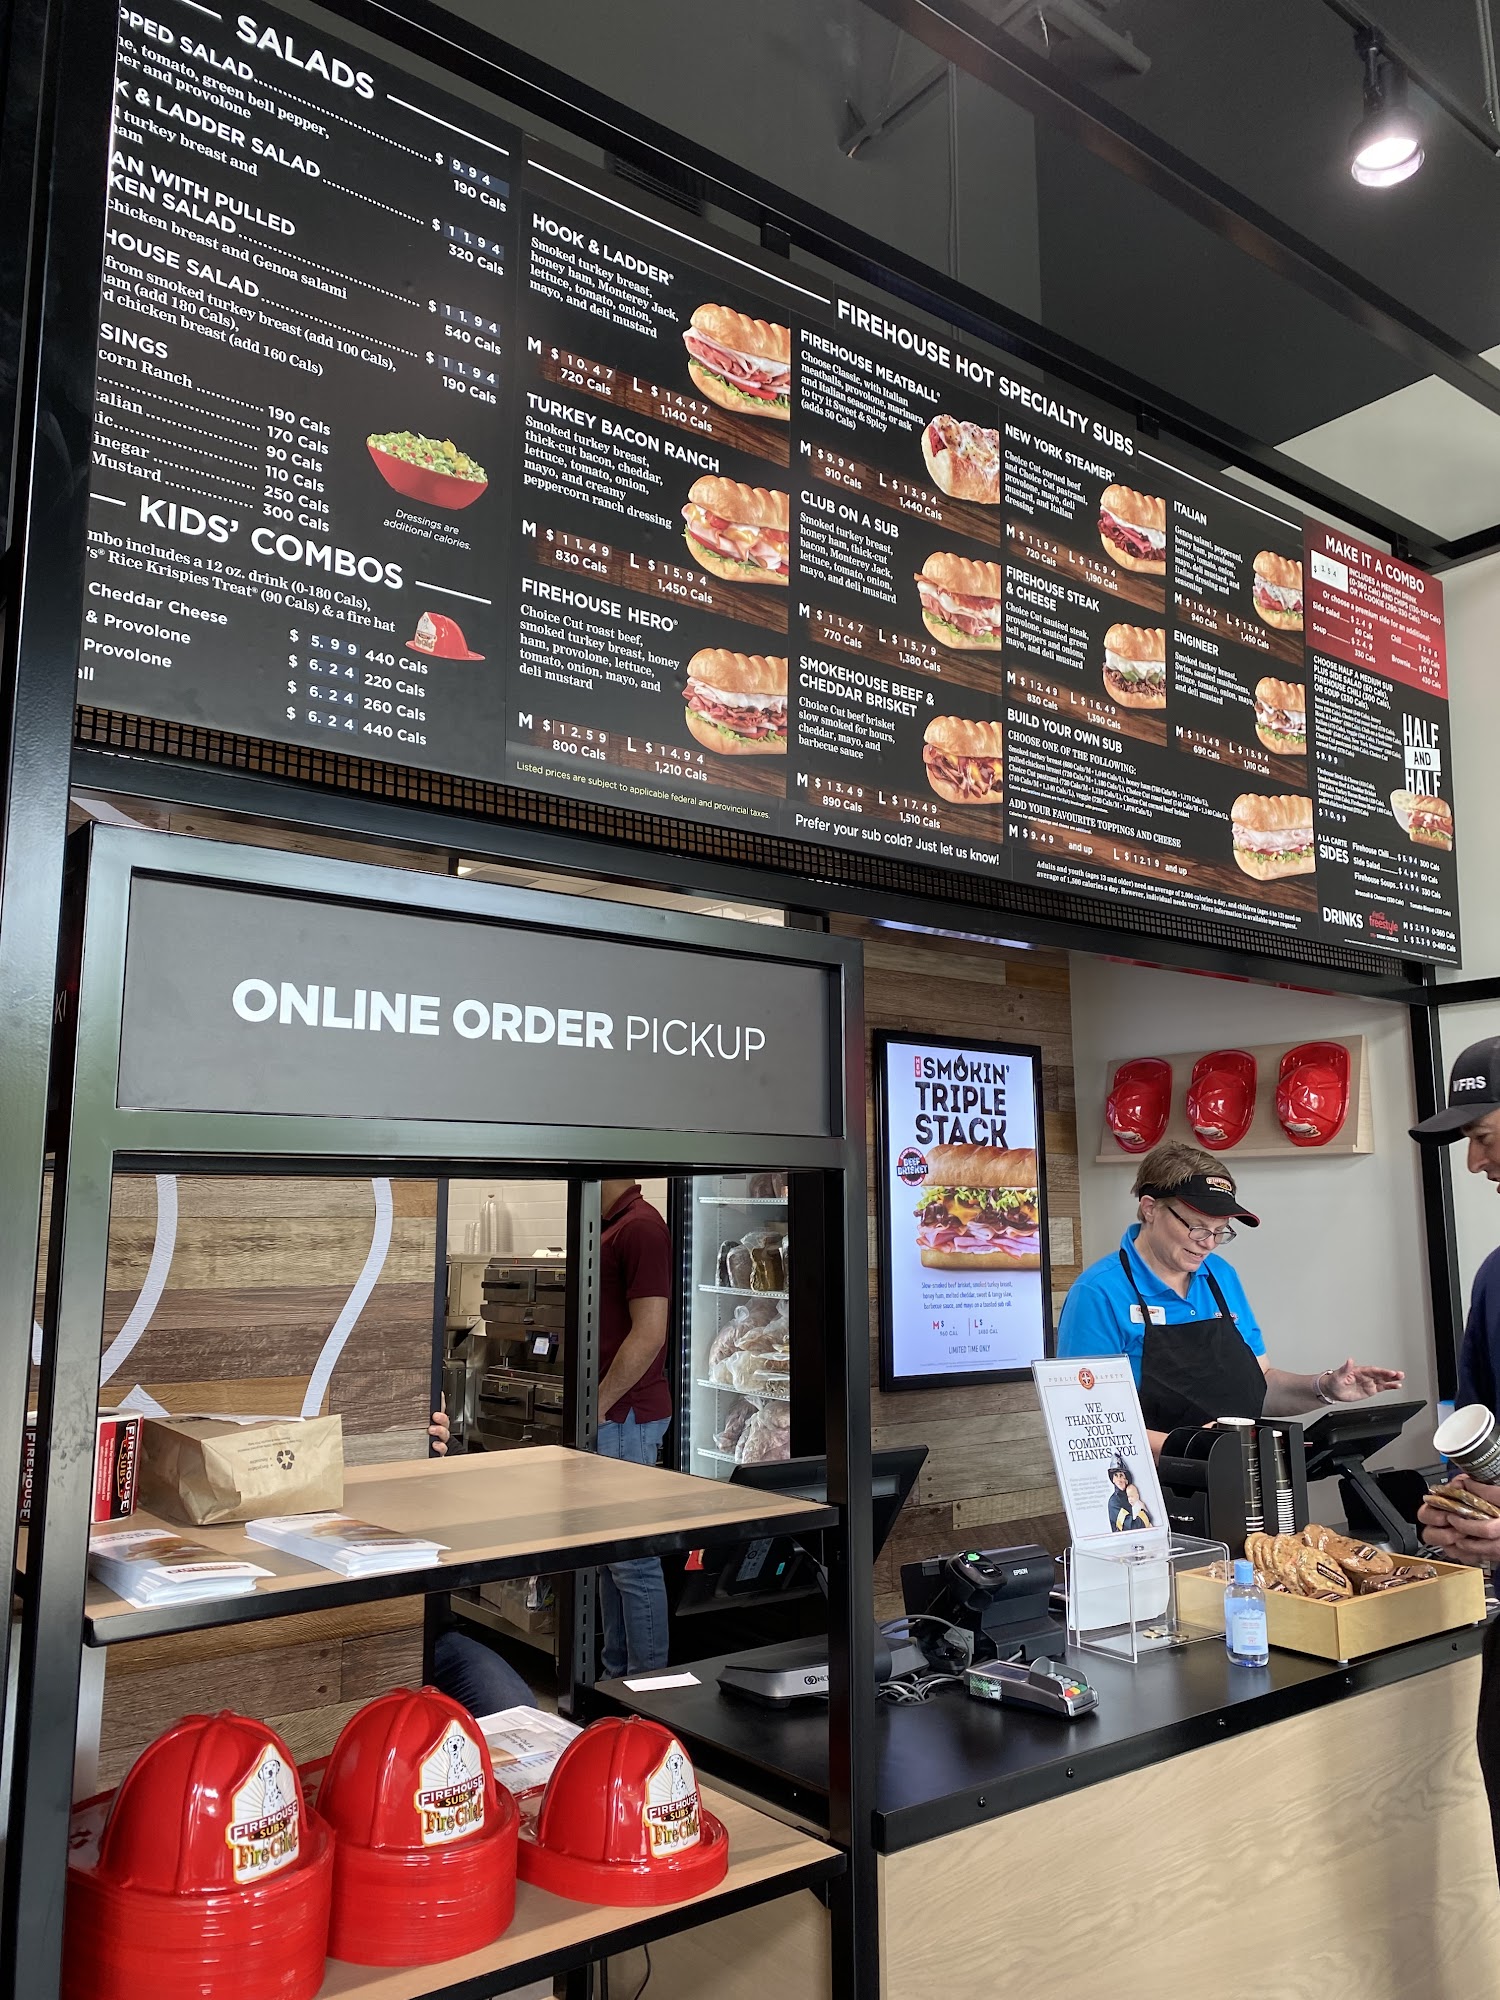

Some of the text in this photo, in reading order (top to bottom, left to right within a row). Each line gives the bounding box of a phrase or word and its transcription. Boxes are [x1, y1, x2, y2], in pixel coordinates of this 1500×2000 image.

[180, 36, 253, 80] SALAD
[236, 15, 374, 99] SALADS
[135, 88, 150, 106] &
[156, 95, 245, 147] LADDER
[251, 137, 320, 177] SALAD
[151, 165, 208, 203] WITH
[215, 192, 295, 235] PULLED
[162, 193, 235, 233] SALAD
[533, 213, 584, 248] HOOK
[588, 239, 599, 255] &
[171, 221, 219, 250] breast
[222, 244, 249, 262] and
[253, 254, 298, 280] Genoa
[301, 275, 347, 299] salami
[186, 259, 259, 297] SALAD
[531, 237, 652, 298] Smoked turkey breast,
[100, 323, 167, 358] SINGS
[801, 329, 872, 373] FIREHOUSE
[141, 360, 192, 388] Ranch
[561, 368, 611, 395] 720 Cals
[838, 300, 1133, 456] FIREHOUSE HOT SPECIALTY SUBS
[527, 392, 719, 473] TURKEY BACON RANCH
[660, 405, 712, 432] 1,140 Cals
[1005, 423, 1031, 445] NEW
[1033, 436, 1062, 460] YORK
[395, 509, 459, 534] Dressings are
[801, 490, 898, 538] CLUB ON A SUB
[1174, 501, 1206, 526] ITALIAN
[140, 495, 402, 589] KIDS' COMBOS
[383, 519, 471, 550] additional calories.
[1326, 535, 1424, 593] MAKE IT A COMBO
[88, 582, 227, 624] Cheddar Cheese
[522, 577, 621, 618] FIREHOUSE
[1006, 566, 1099, 612] FIREHOUSE STEAK
[1006, 582, 1056, 611] & CHEESE
[86, 610, 190, 644] & Provolone
[1174, 630, 1218, 656] ENGINEER
[84, 638, 172, 667] Provolone
[799, 673, 917, 717] CHEDDAR BRISKET
[800, 656, 934, 706] SMOKEHOUSE BEEF &
[1008, 708, 1122, 753] BUILD YOUR OWN SUB
[1403, 713, 1439, 748] HALF
[1008, 730, 1136, 775] CHOOSE ONE OF THE FOLLOWING:
[1414, 751, 1432, 766] AND
[517, 761, 543, 774] Listed
[545, 769, 570, 780] prices
[573, 774, 586, 783] are
[588, 778, 617, 789] subject
[619, 783, 628, 791] to
[630, 786, 669, 799] applicable
[671, 792, 696, 804] federal
[714, 803, 748, 814] provincial
[750, 808, 770, 818] taxes.
[1405, 770, 1441, 798] HALF
[796, 814, 999, 865] Prefer your sub cold? Just let us know!
[1009, 798, 1181, 848] ADD YOUR FAVOURITE TOPPINGS AND CHEESE
[1317, 833, 1347, 848] A LA CARTE
[1319, 845, 1349, 864] SIDES
[1323, 907, 1363, 928] DRINKS
[233, 978, 766, 1060] ONLINE ORDER PICKUP
[915, 1082, 1006, 1116] TRIPLE
[916, 1114, 1008, 1149] STACK
[1065, 1412, 1126, 1426] THANK YOU.
[1085, 1403, 1102, 1413] WE
[1069, 1434, 1133, 1450] COMMUNITY
[1085, 1425, 1114, 1436] YOUR
[120, 1426, 135, 1511] FIREHOUSE
[1069, 1446, 1138, 1462] THANKS YOU.
[20, 1433, 36, 1518] FIREHOUSE
[1013, 1568, 1028, 1576] EPSON
[421, 1775, 483, 1808] FIREHOUSE
[446, 1792, 469, 1806] SUBS
[234, 1801, 297, 1841] FIREHOUSE
[260, 1821, 284, 1838] SUBS
[671, 1808, 688, 1820] SUBS
